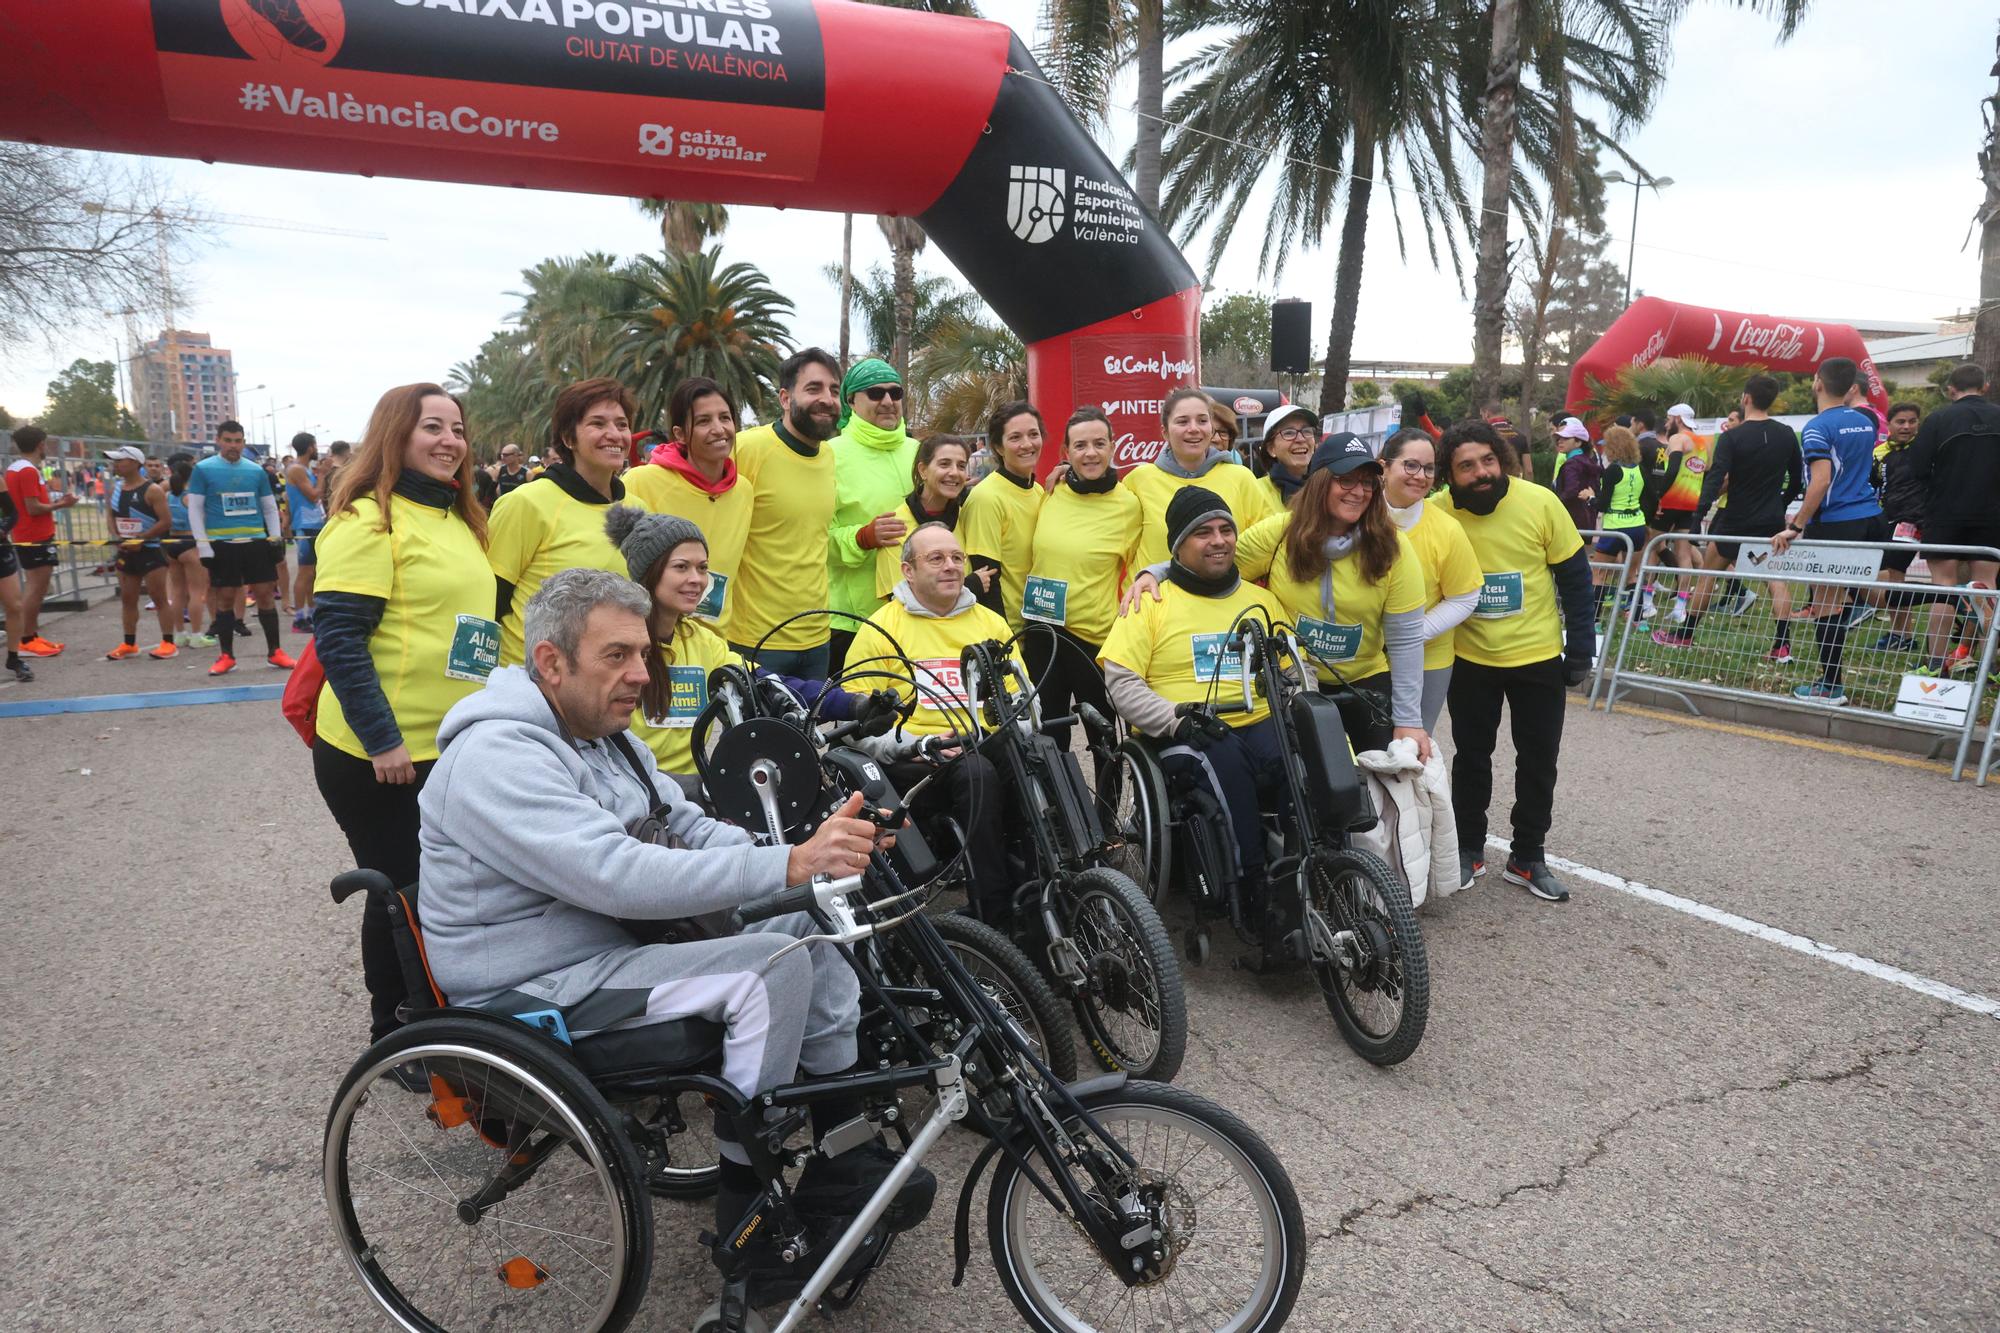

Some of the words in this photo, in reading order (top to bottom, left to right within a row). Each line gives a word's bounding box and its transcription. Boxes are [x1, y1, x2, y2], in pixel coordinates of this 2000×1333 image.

[563, 0, 783, 55] POPULAR
[565, 36, 644, 65] CIUTAT
[650, 47, 679, 69] DE
[683, 51, 788, 82] VALÈNCIA
[238, 82, 559, 142] #ValènciaCorre
[679, 129, 737, 147] caixa
[678, 144, 767, 162] popular
[1074, 175, 1133, 200] Fundació
[1074, 192, 1140, 216] Esportiva
[1074, 209, 1144, 230] Municipal
[1073, 226, 1138, 244] València
[1104, 355, 1122, 375] El
[1122, 355, 1159, 375] Corte
[1160, 351, 1195, 380] Inglés
[1121, 399, 1165, 415] INTER
[1767, 560, 1803, 571] CIUDAD
[1806, 562, 1824, 573] DEL
[1827, 564, 1872, 576] RUNNING
[1031, 586, 1042, 597] Al
[1043, 588, 1056, 599] teu
[1485, 584, 1506, 593] teu
[1034, 597, 1056, 609] Ritme
[468, 631, 485, 646] Al
[486, 635, 499, 650] teu
[1308, 628, 1324, 640] Al
[1325, 632, 1346, 643] teu
[1313, 638, 1346, 651] Ritme
[473, 647, 497, 664] Ritme
